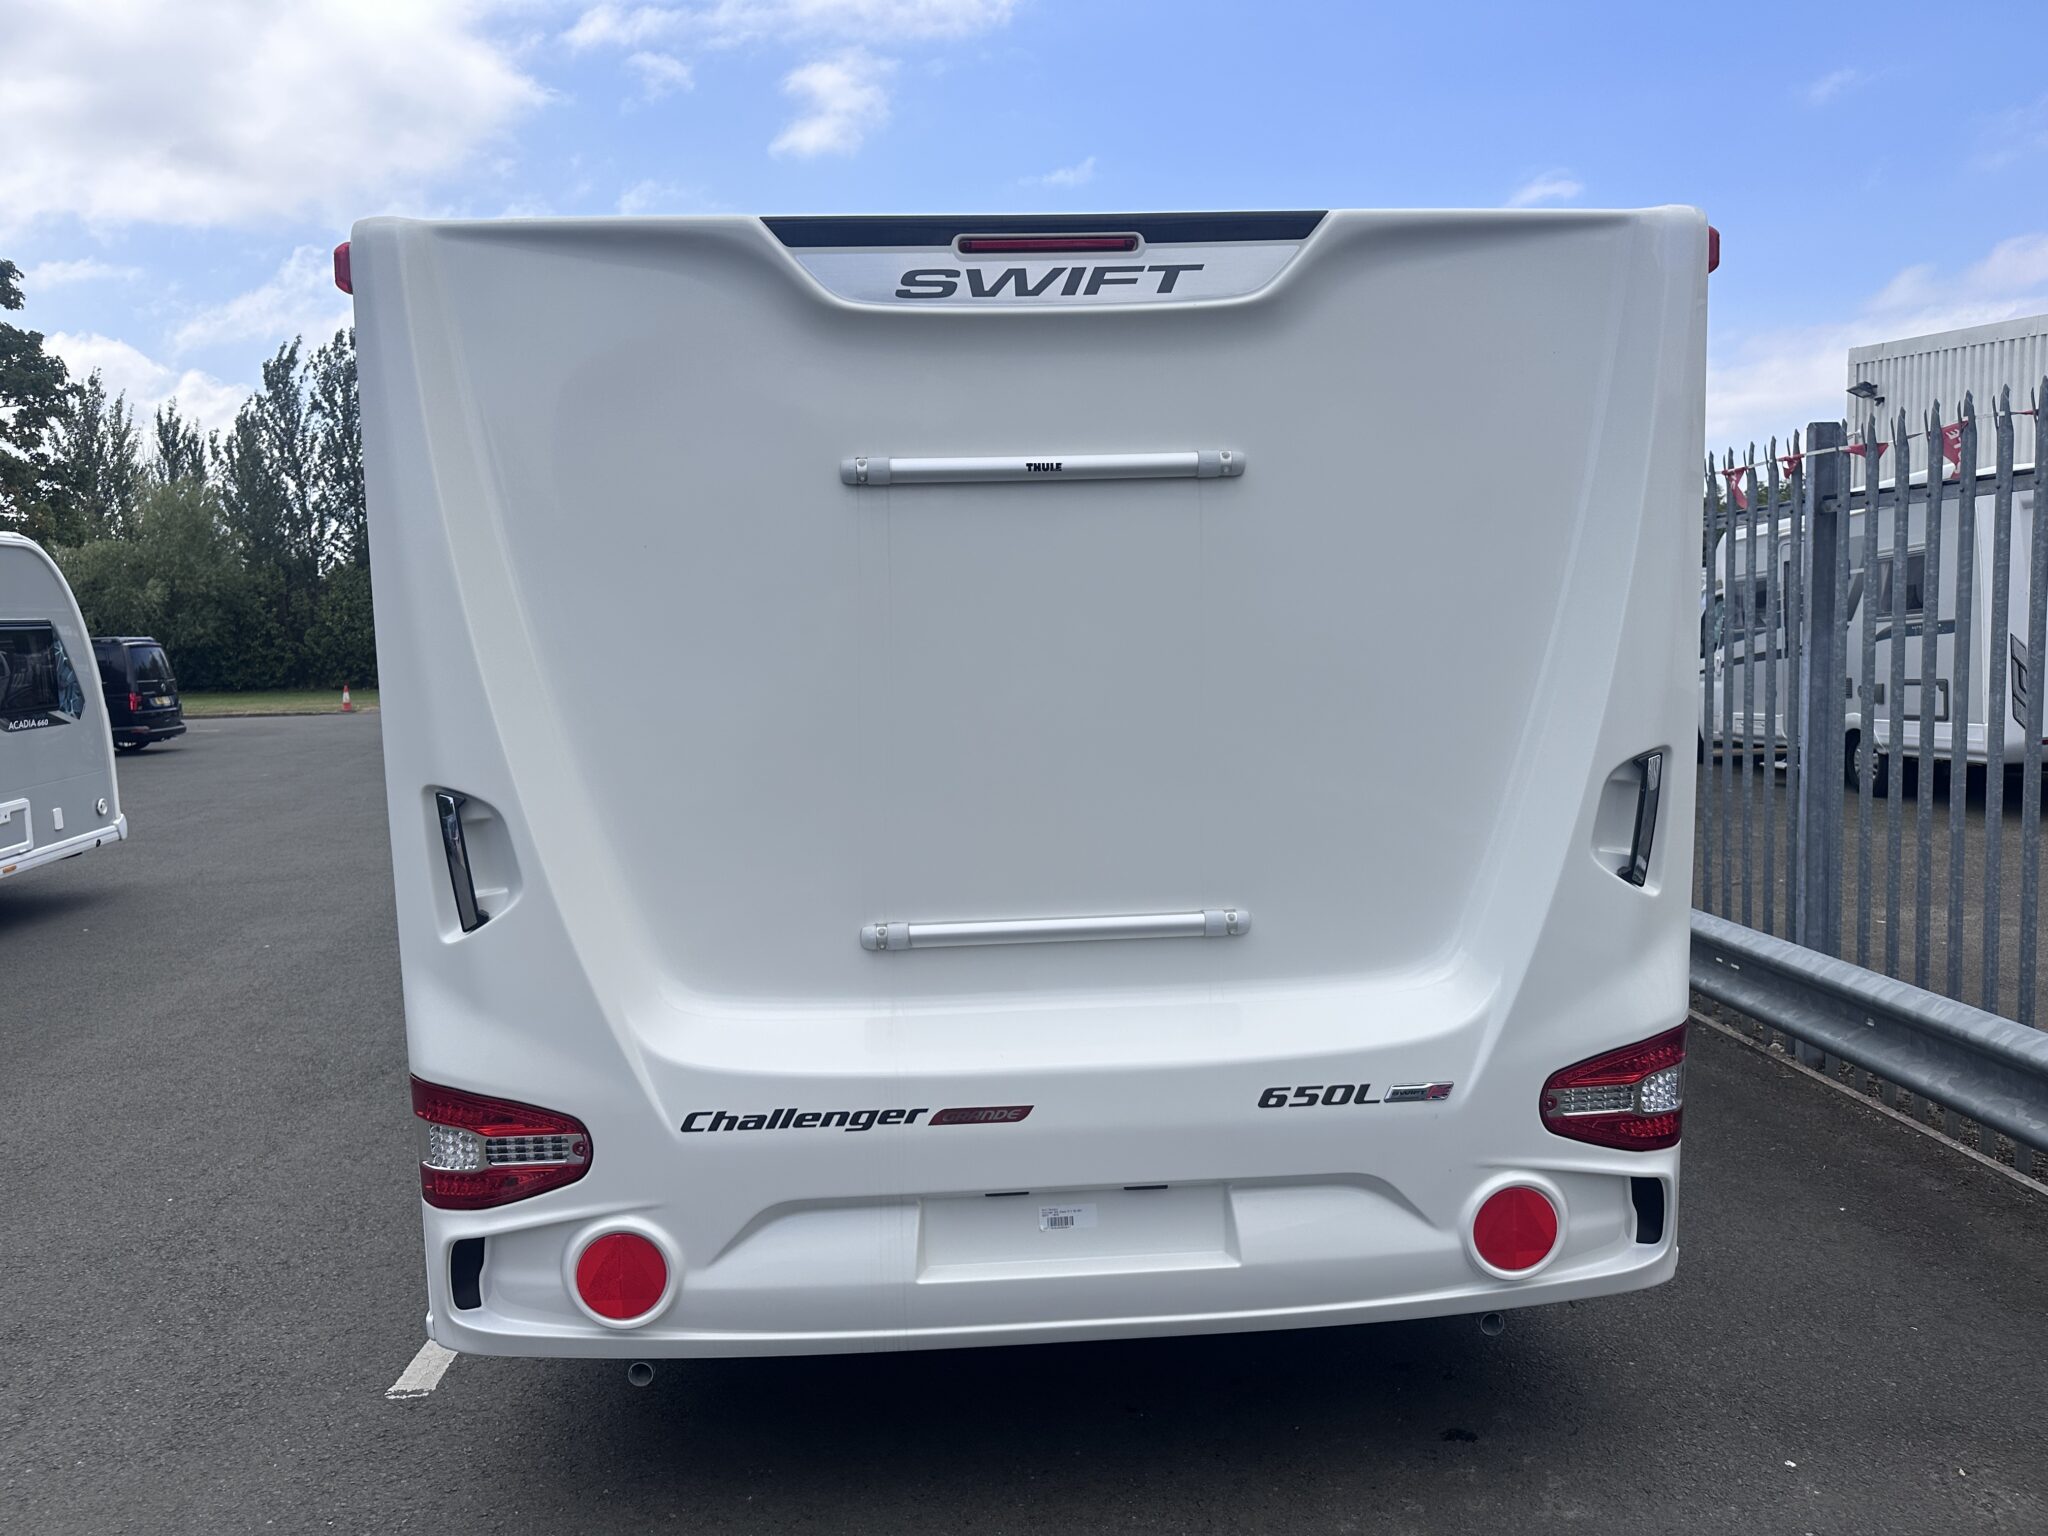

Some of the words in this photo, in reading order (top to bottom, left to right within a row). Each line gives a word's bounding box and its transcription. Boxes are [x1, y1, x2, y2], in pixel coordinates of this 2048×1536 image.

[895, 264, 1205, 298] SWIFT
[1026, 462, 1063, 472] THULE
[8, 719, 37, 730] ACADIA
[37, 718, 49, 727] 660
[1258, 1084, 1380, 1108] 650L
[680, 1108, 929, 1132] Challenger
[943, 1109, 1021, 1122] GRANDE
